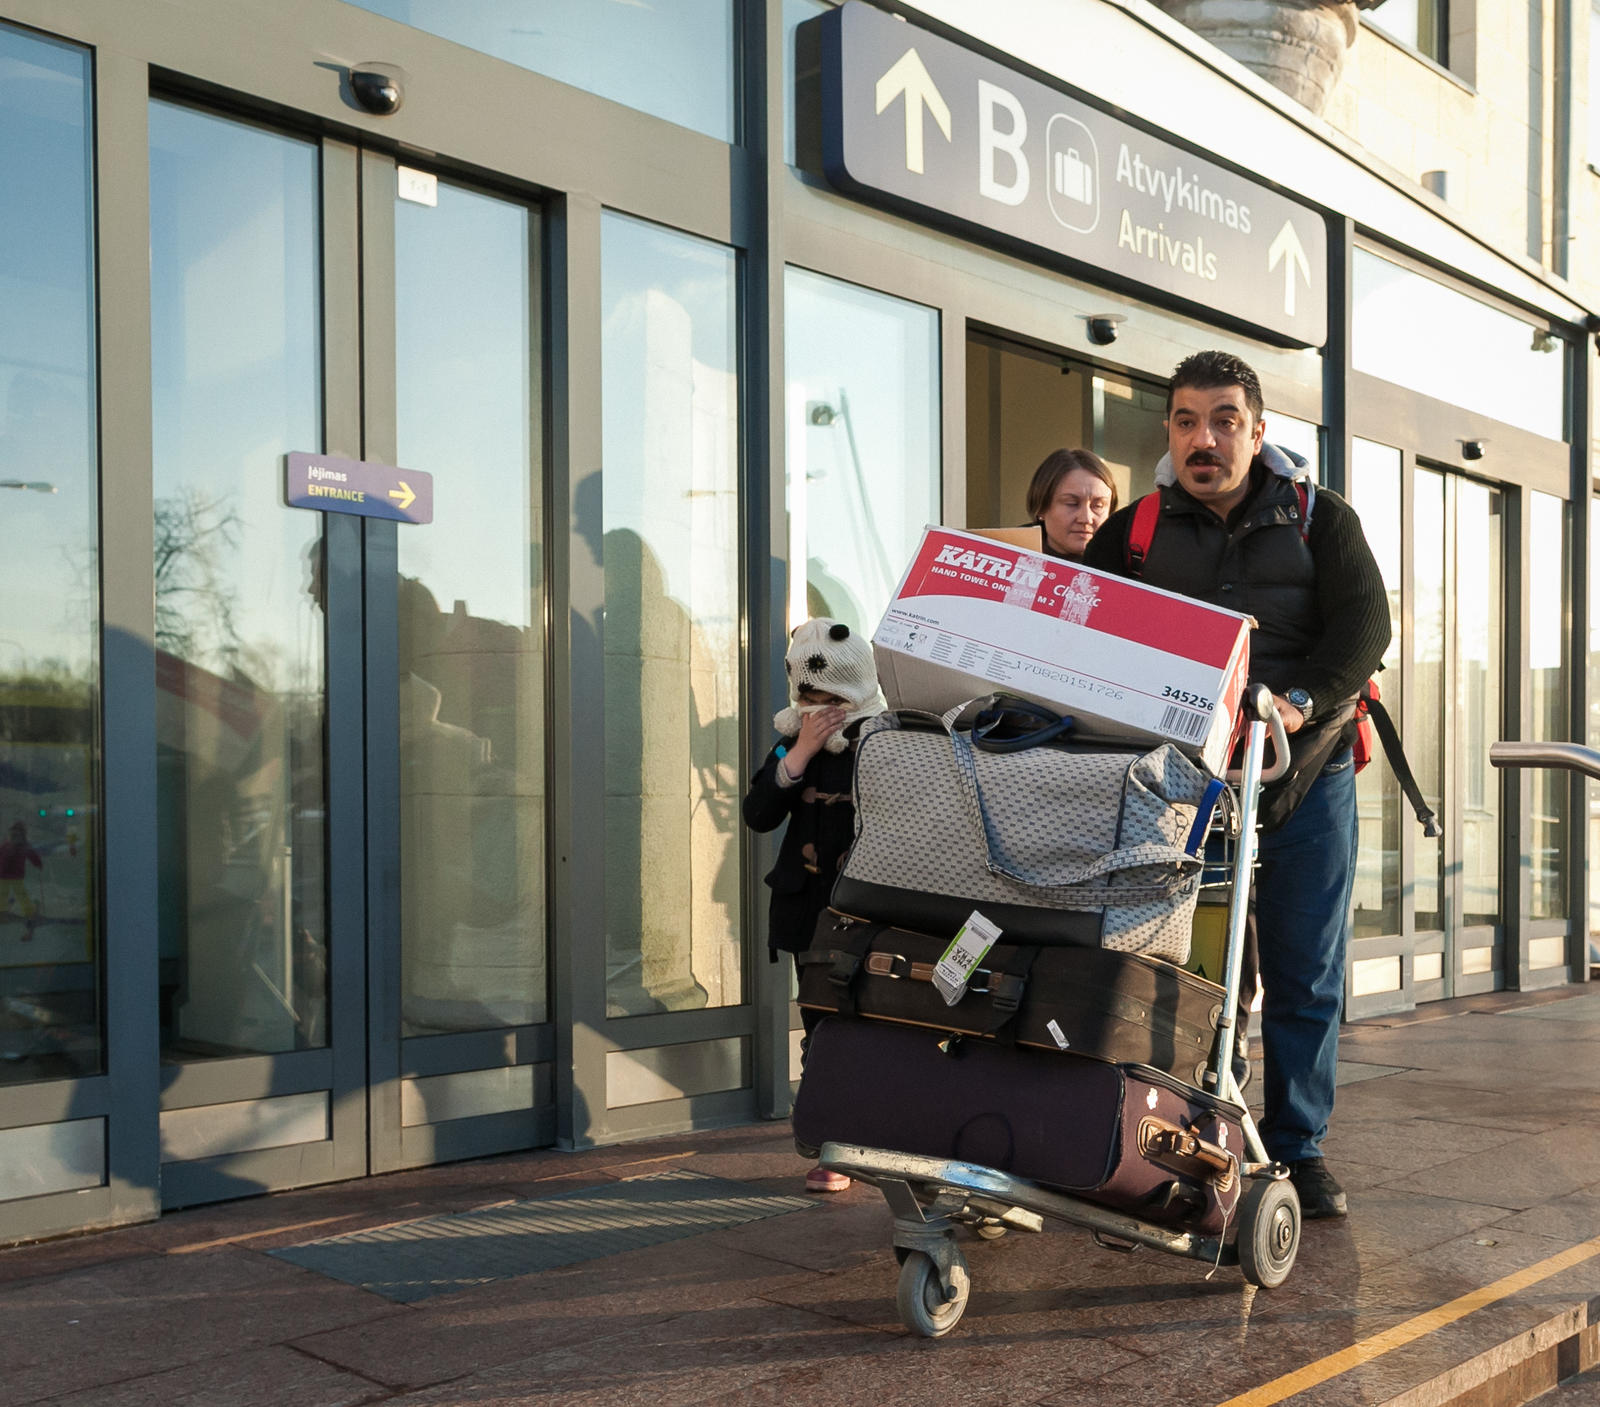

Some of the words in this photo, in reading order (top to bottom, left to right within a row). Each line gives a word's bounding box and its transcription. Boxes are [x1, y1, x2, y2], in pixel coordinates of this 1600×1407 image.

[978, 79, 1030, 207] B
[1116, 143, 1252, 235] Atvykimas
[1118, 209, 1218, 282] Arrivals
[308, 465, 348, 482] Įėjimas
[308, 484, 365, 503] ENTRANCE
[931, 566, 957, 578] HAND
[960, 573, 989, 588] TOWEL
[991, 582, 1011, 593] ONE
[1037, 596, 1047, 604] M
[1048, 599, 1056, 607] 2
[1053, 584, 1102, 608] Classic
[891, 608, 940, 626] www.katrin.com
[1017, 660, 1124, 701] 170820151726
[1161, 685, 1214, 712] 345256
